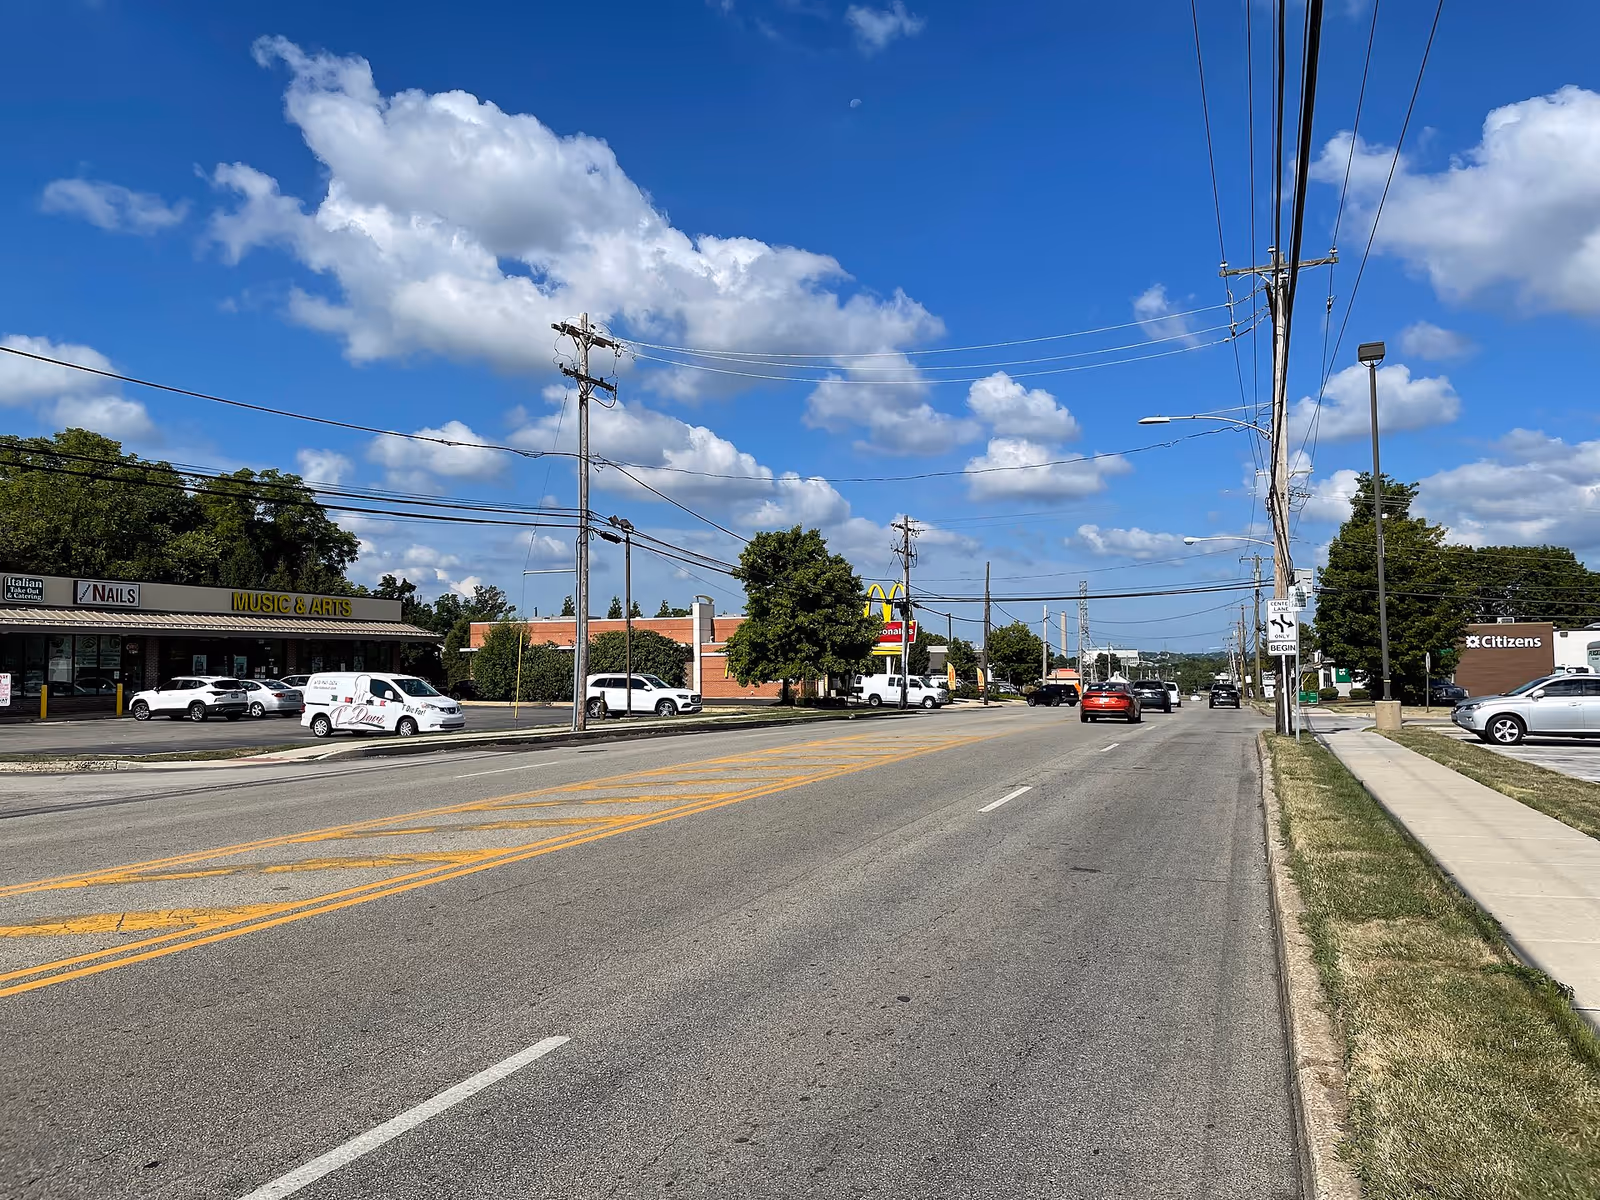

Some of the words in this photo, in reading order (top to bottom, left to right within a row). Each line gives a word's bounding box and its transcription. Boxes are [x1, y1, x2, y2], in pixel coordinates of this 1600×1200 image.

[7, 577, 42, 588] Italian
[13, 592, 42, 601] Catering
[92, 584, 136, 604] NAILS
[232, 591, 291, 613] MUSIC
[294, 596, 306, 614] &
[309, 597, 352, 616] ARTS
[1481, 635, 1542, 648] Citizens
[1270, 644, 1296, 652] BEGIN
